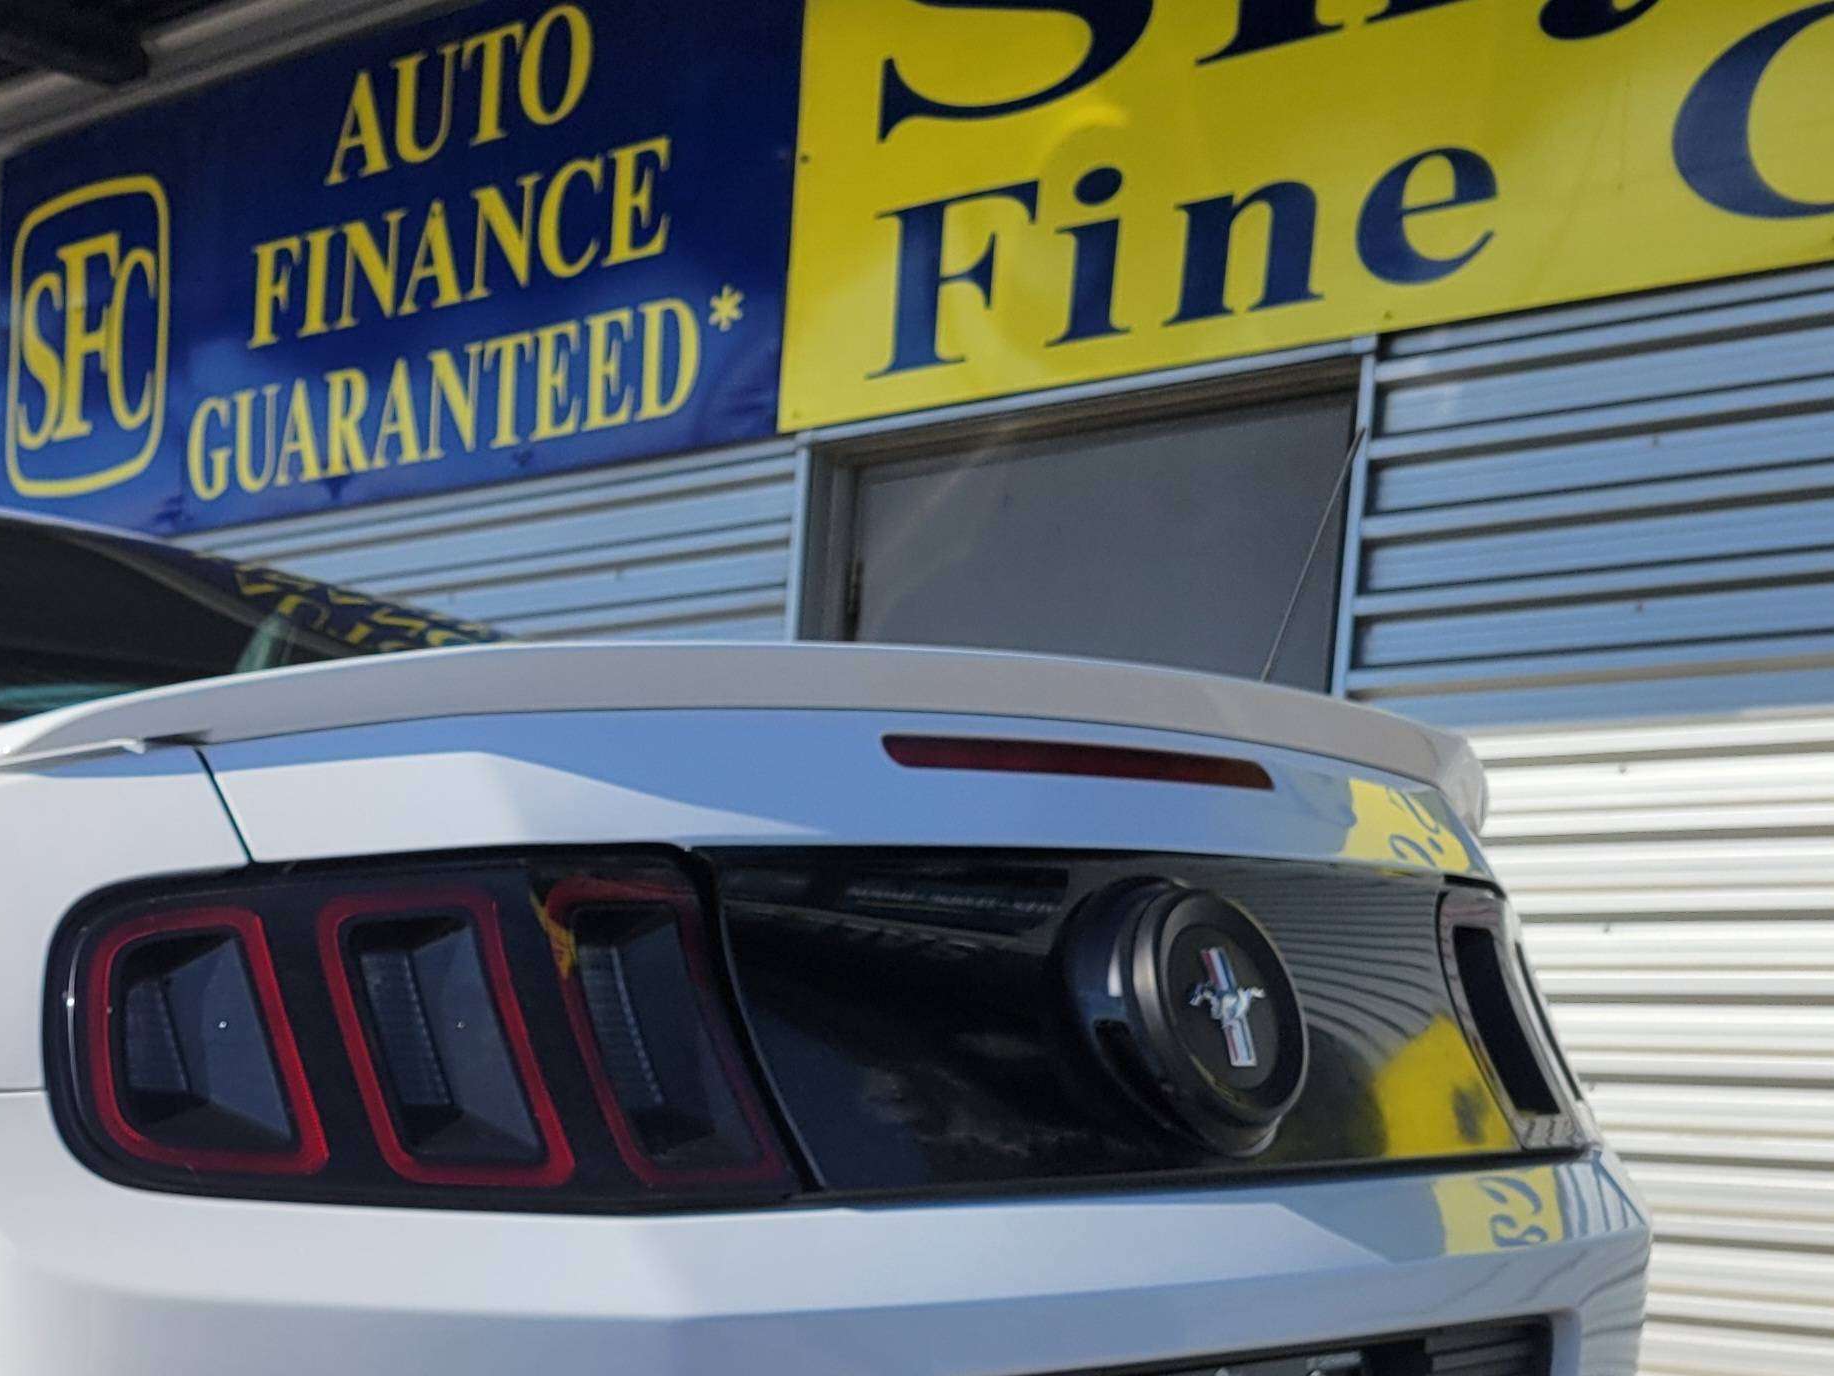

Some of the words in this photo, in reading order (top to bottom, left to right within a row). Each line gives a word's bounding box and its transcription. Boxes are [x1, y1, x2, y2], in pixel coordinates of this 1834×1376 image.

[326, 4, 594, 186] AUTO
[17, 231, 159, 451] SFC
[246, 136, 672, 349] FINANCE
[865, 144, 1498, 379] Fine
